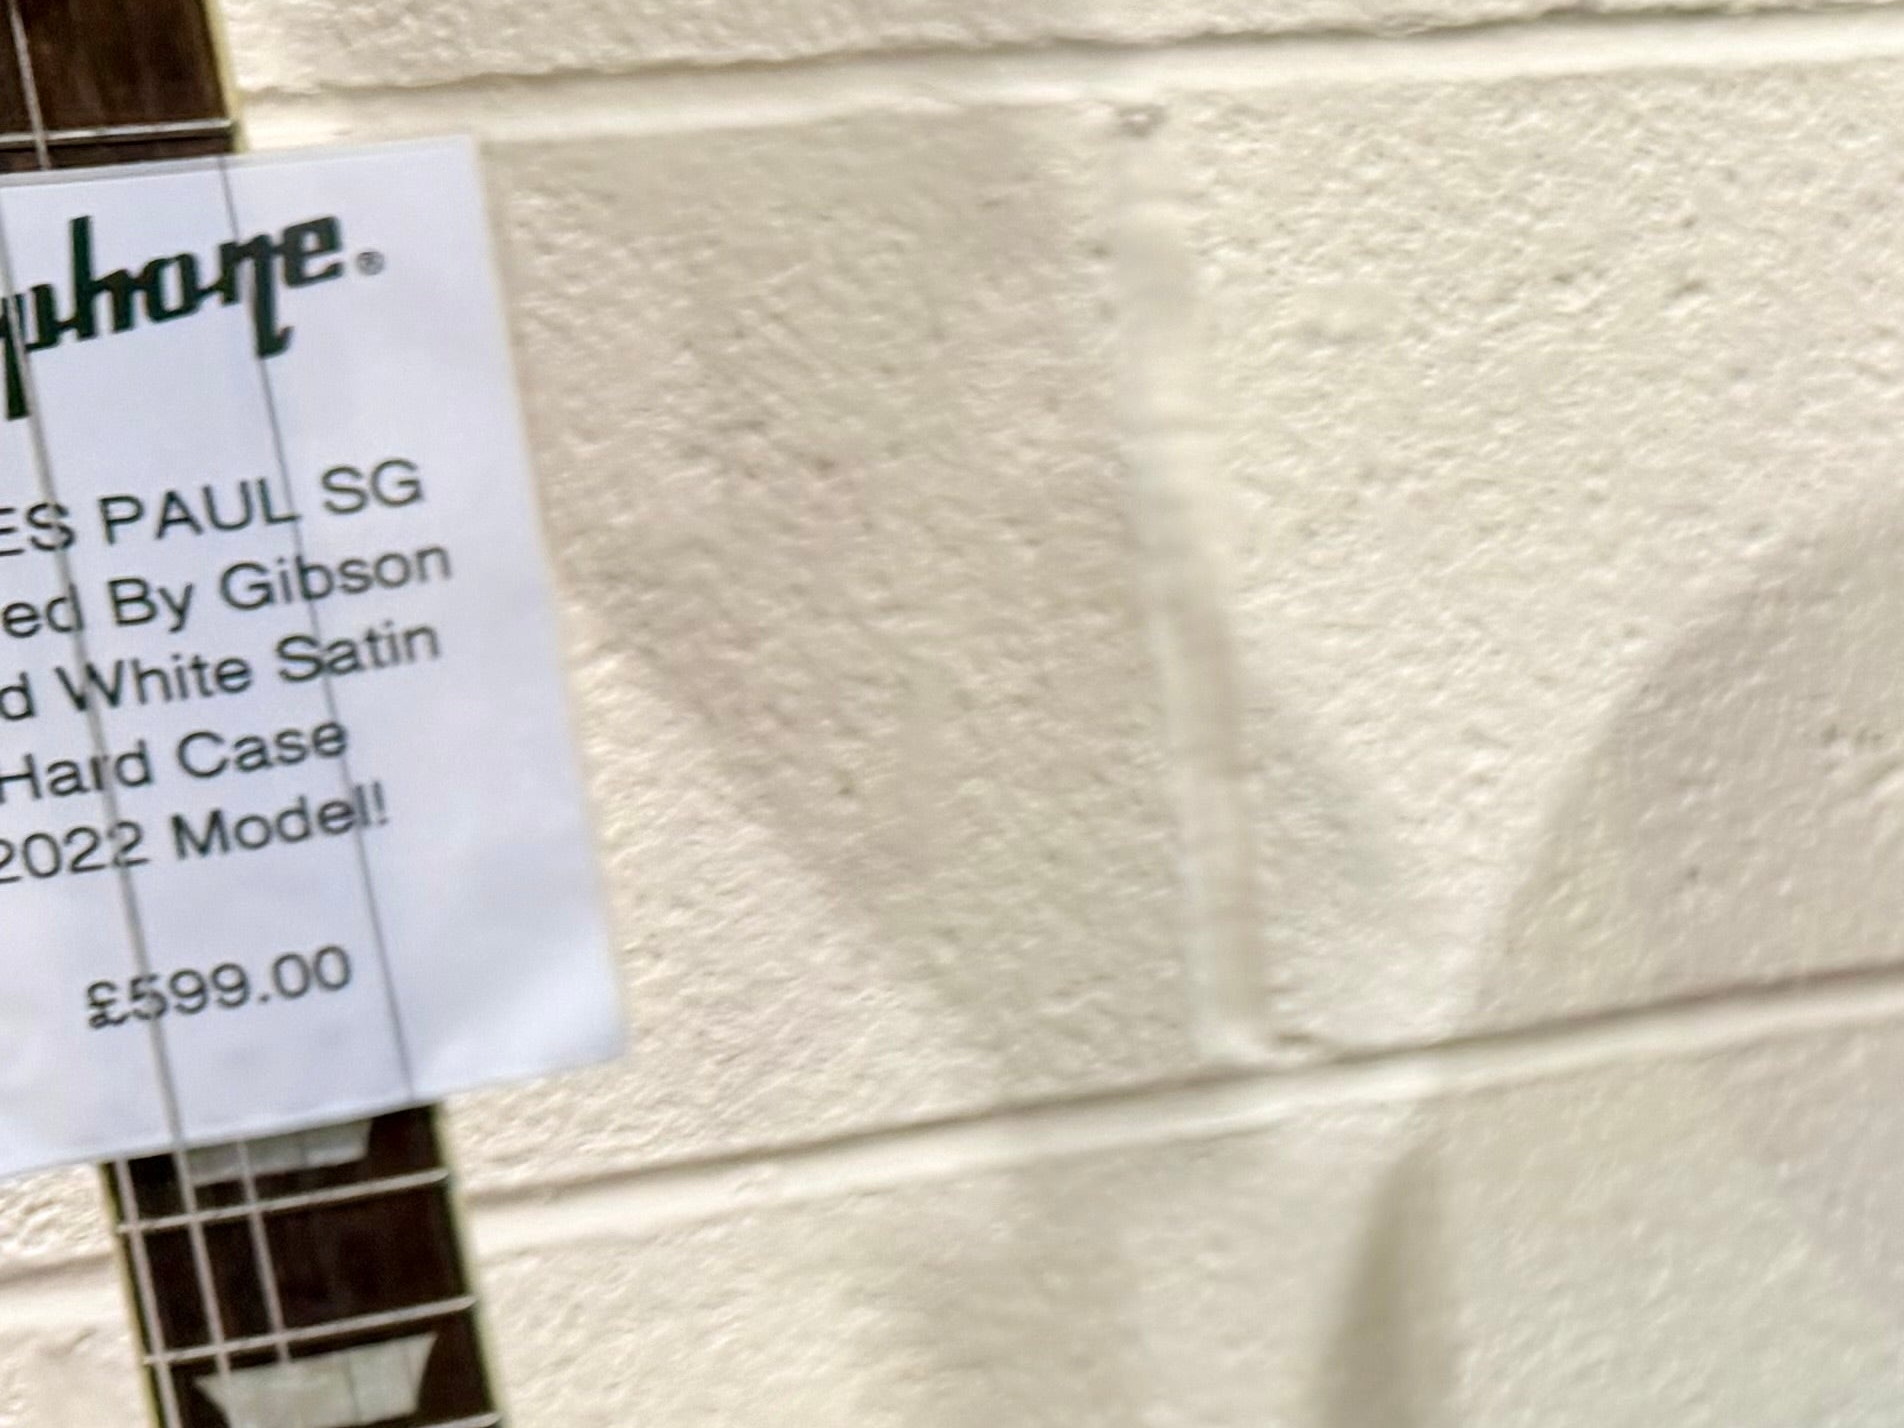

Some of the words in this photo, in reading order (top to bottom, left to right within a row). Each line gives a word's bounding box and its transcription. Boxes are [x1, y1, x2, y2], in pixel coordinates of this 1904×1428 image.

[98, 478, 301, 545] PAUL
[320, 457, 425, 515] SG
[107, 577, 194, 633] By
[219, 544, 451, 611] Gibson
[55, 652, 253, 713] White
[275, 620, 441, 683] Satin
[176, 721, 348, 779] Case
[170, 780, 390, 861] Model!
[86, 945, 353, 1030] £599.00
